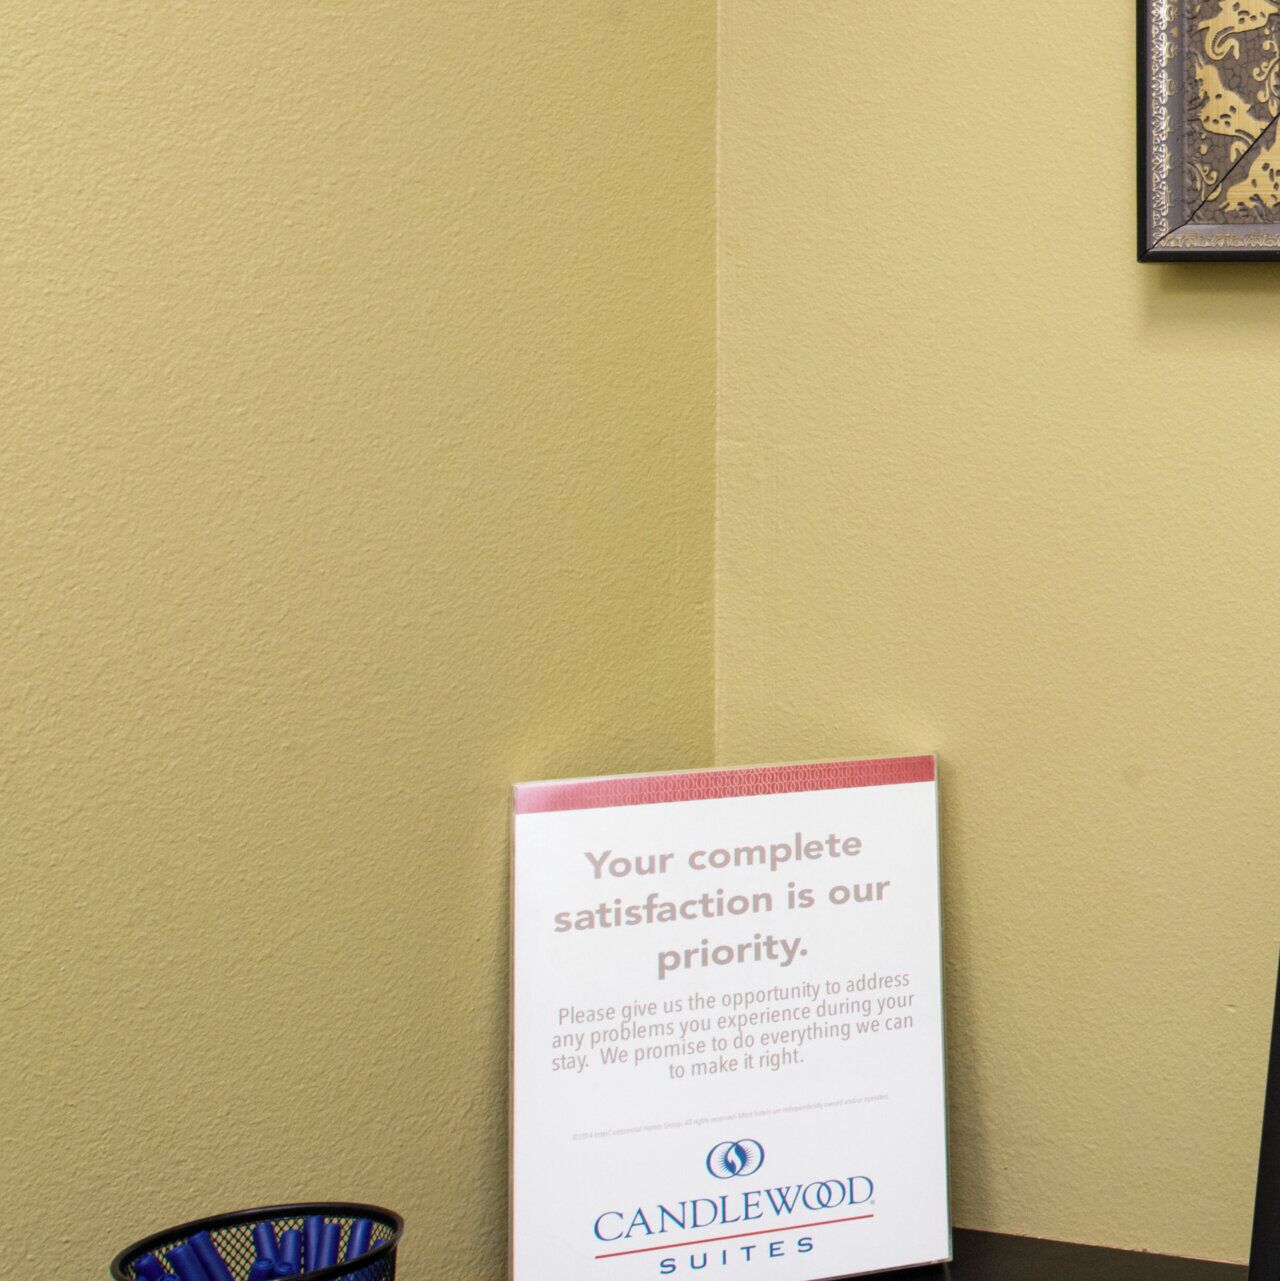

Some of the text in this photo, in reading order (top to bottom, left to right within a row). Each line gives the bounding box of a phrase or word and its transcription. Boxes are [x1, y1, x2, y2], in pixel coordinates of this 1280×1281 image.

[584, 831, 863, 879] Your complete
[554, 877, 891, 933] satisfaction is our
[657, 933, 808, 980] priority.
[552, 994, 914, 1051] any problems you experience during your
[559, 972, 910, 1025] Please give us the opportunity to address
[552, 1015, 913, 1073] stay. We promise to do everything we can
[669, 1048, 804, 1080] to make it right.
[660, 1237, 815, 1274] SUITES
